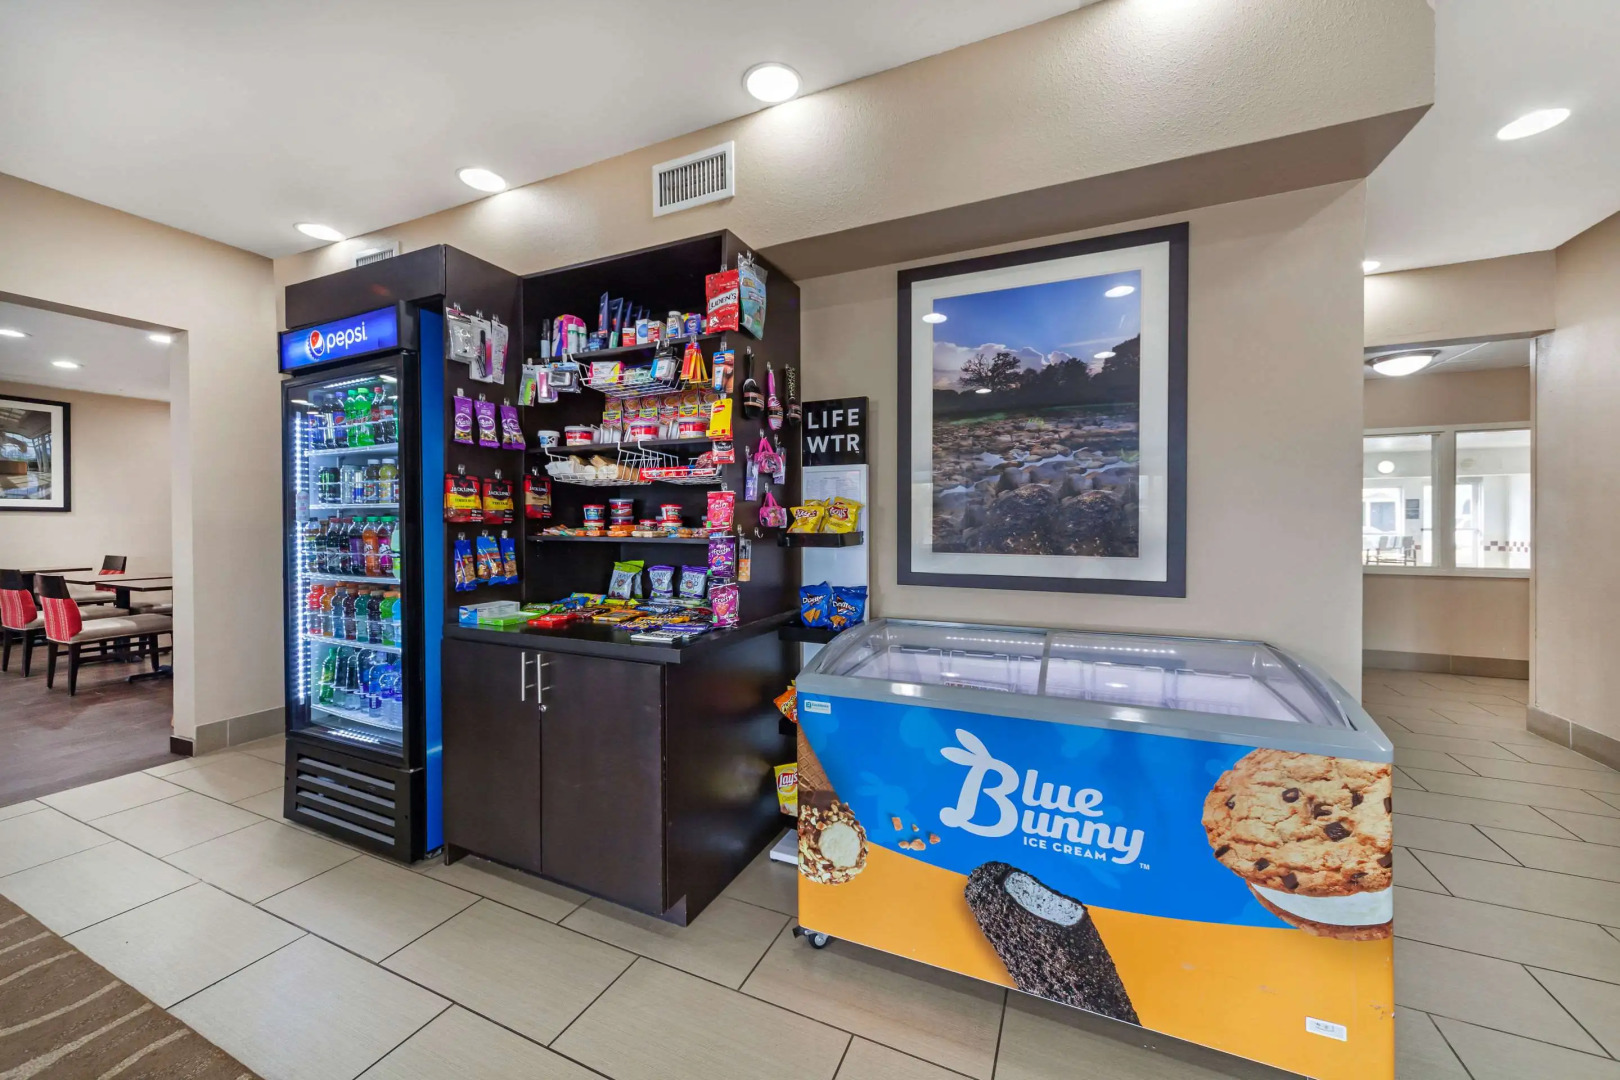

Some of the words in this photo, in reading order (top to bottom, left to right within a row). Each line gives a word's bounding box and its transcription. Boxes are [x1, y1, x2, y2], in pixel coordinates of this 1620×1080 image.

[326, 321, 367, 354] pepsi
[807, 408, 860, 430] LIFE
[806, 433, 860, 453] WTR
[832, 600, 857, 612] Doritos
[940, 728, 1104, 838] Blue
[1023, 836, 1048, 850] ICE
[1052, 842, 1107, 862] CREAM
